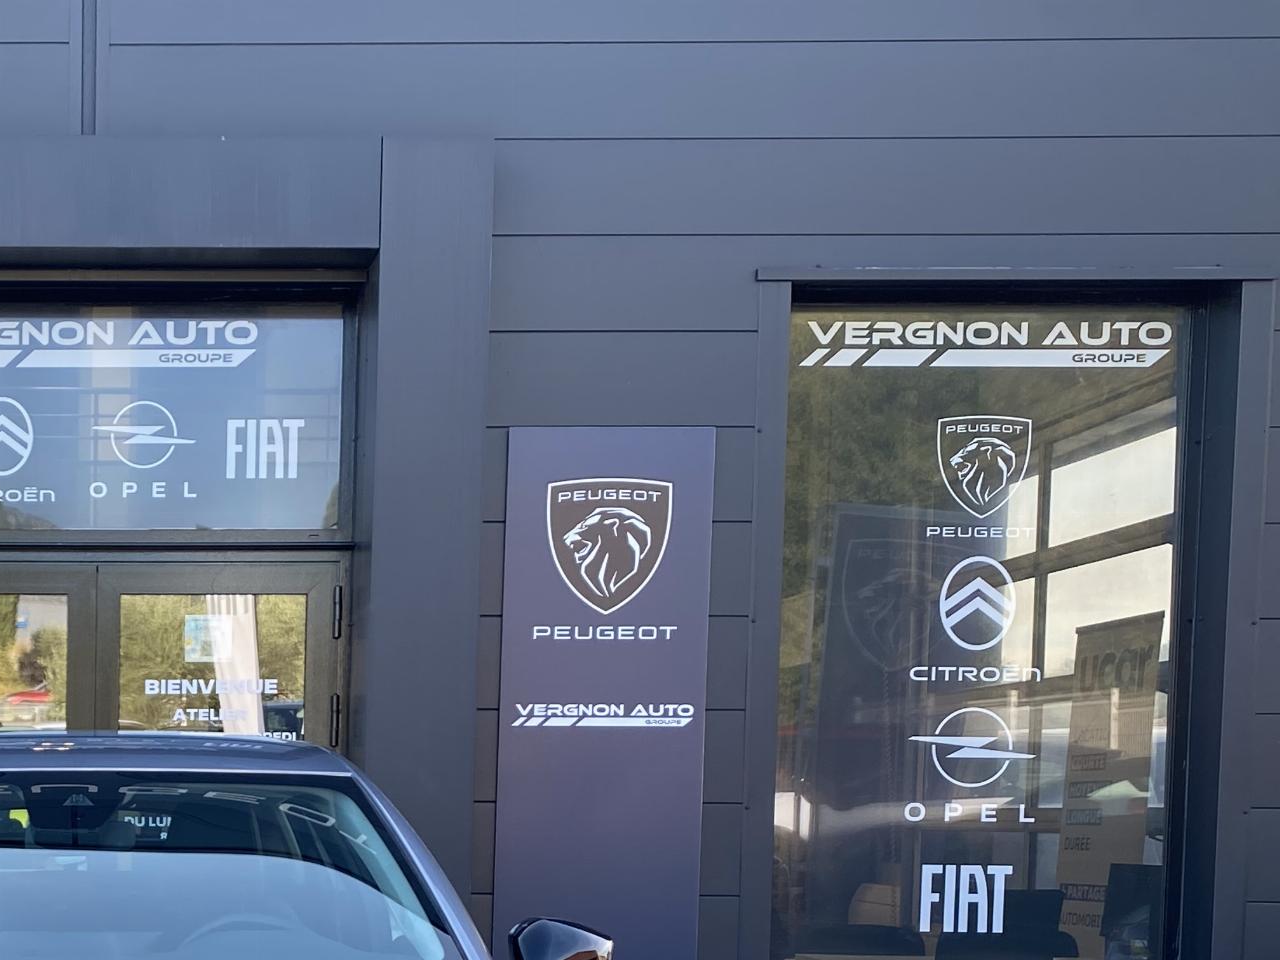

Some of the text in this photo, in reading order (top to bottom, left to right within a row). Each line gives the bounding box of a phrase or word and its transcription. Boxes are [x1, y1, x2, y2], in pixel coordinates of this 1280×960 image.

[127, 320, 258, 346] AUTO
[806, 321, 1172, 346] VERGNON AUTO
[158, 353, 233, 363] GROUPE
[1072, 353, 1147, 363] GROUPE
[945, 424, 1023, 435] PEUGEOT
[226, 419, 305, 479] FIAT
[89, 481, 197, 499] OPEL
[558, 489, 662, 502] PEUGEOT
[926, 526, 1036, 539] PEUGEOT
[532, 626, 678, 640] PEUGEOT
[144, 679, 278, 695] BIENVENUE
[172, 709, 249, 721] ATELIER
[515, 704, 694, 716] VERGNON AUTO
[903, 802, 1036, 823] OPEL
[920, 864, 1013, 933] FIAT
